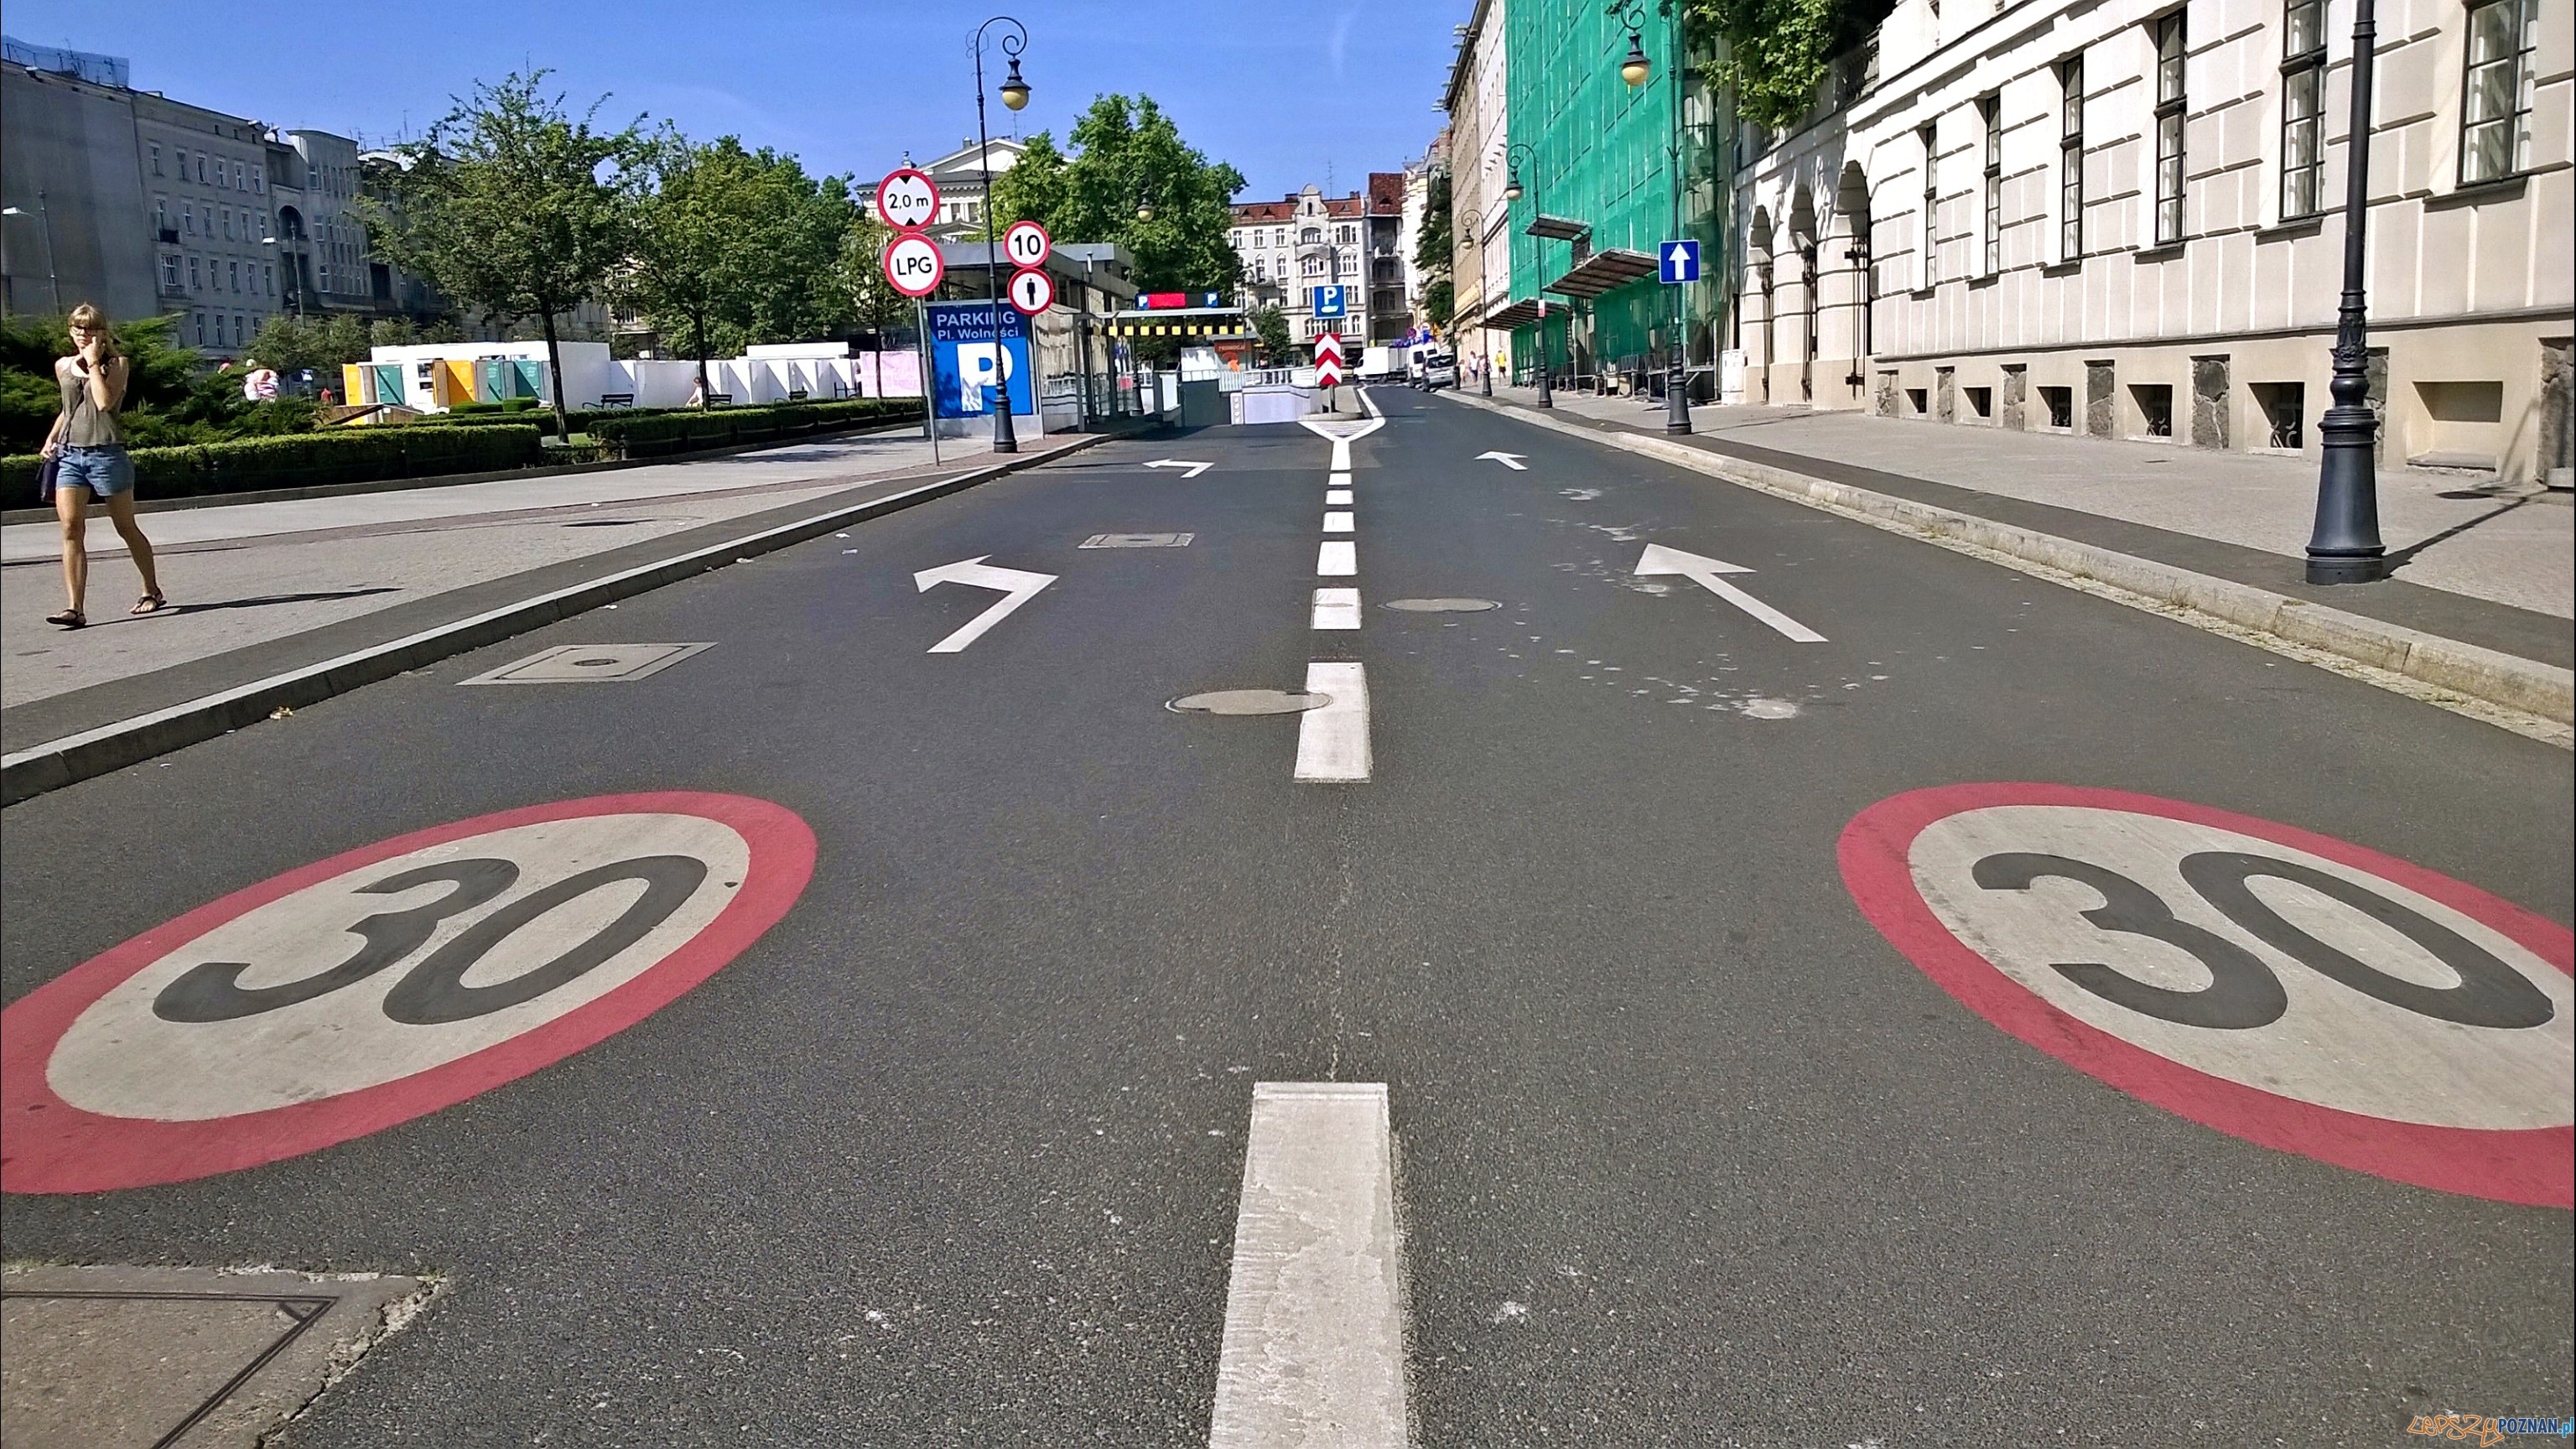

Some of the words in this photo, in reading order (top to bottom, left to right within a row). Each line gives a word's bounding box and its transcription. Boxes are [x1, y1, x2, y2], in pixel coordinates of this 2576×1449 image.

[888, 194, 911, 209] 2,0
[917, 197, 928, 208] m
[1015, 235, 1041, 256] 10
[896, 257, 932, 276] LPG
[1138, 296, 1148, 307] P
[1208, 293, 1218, 305] P
[1324, 286, 1337, 305] P
[937, 330, 954, 340] Pl.
[957, 342, 1013, 412] P
[152, 854, 708, 1025] 30
[1971, 851, 2555, 1030] 30
